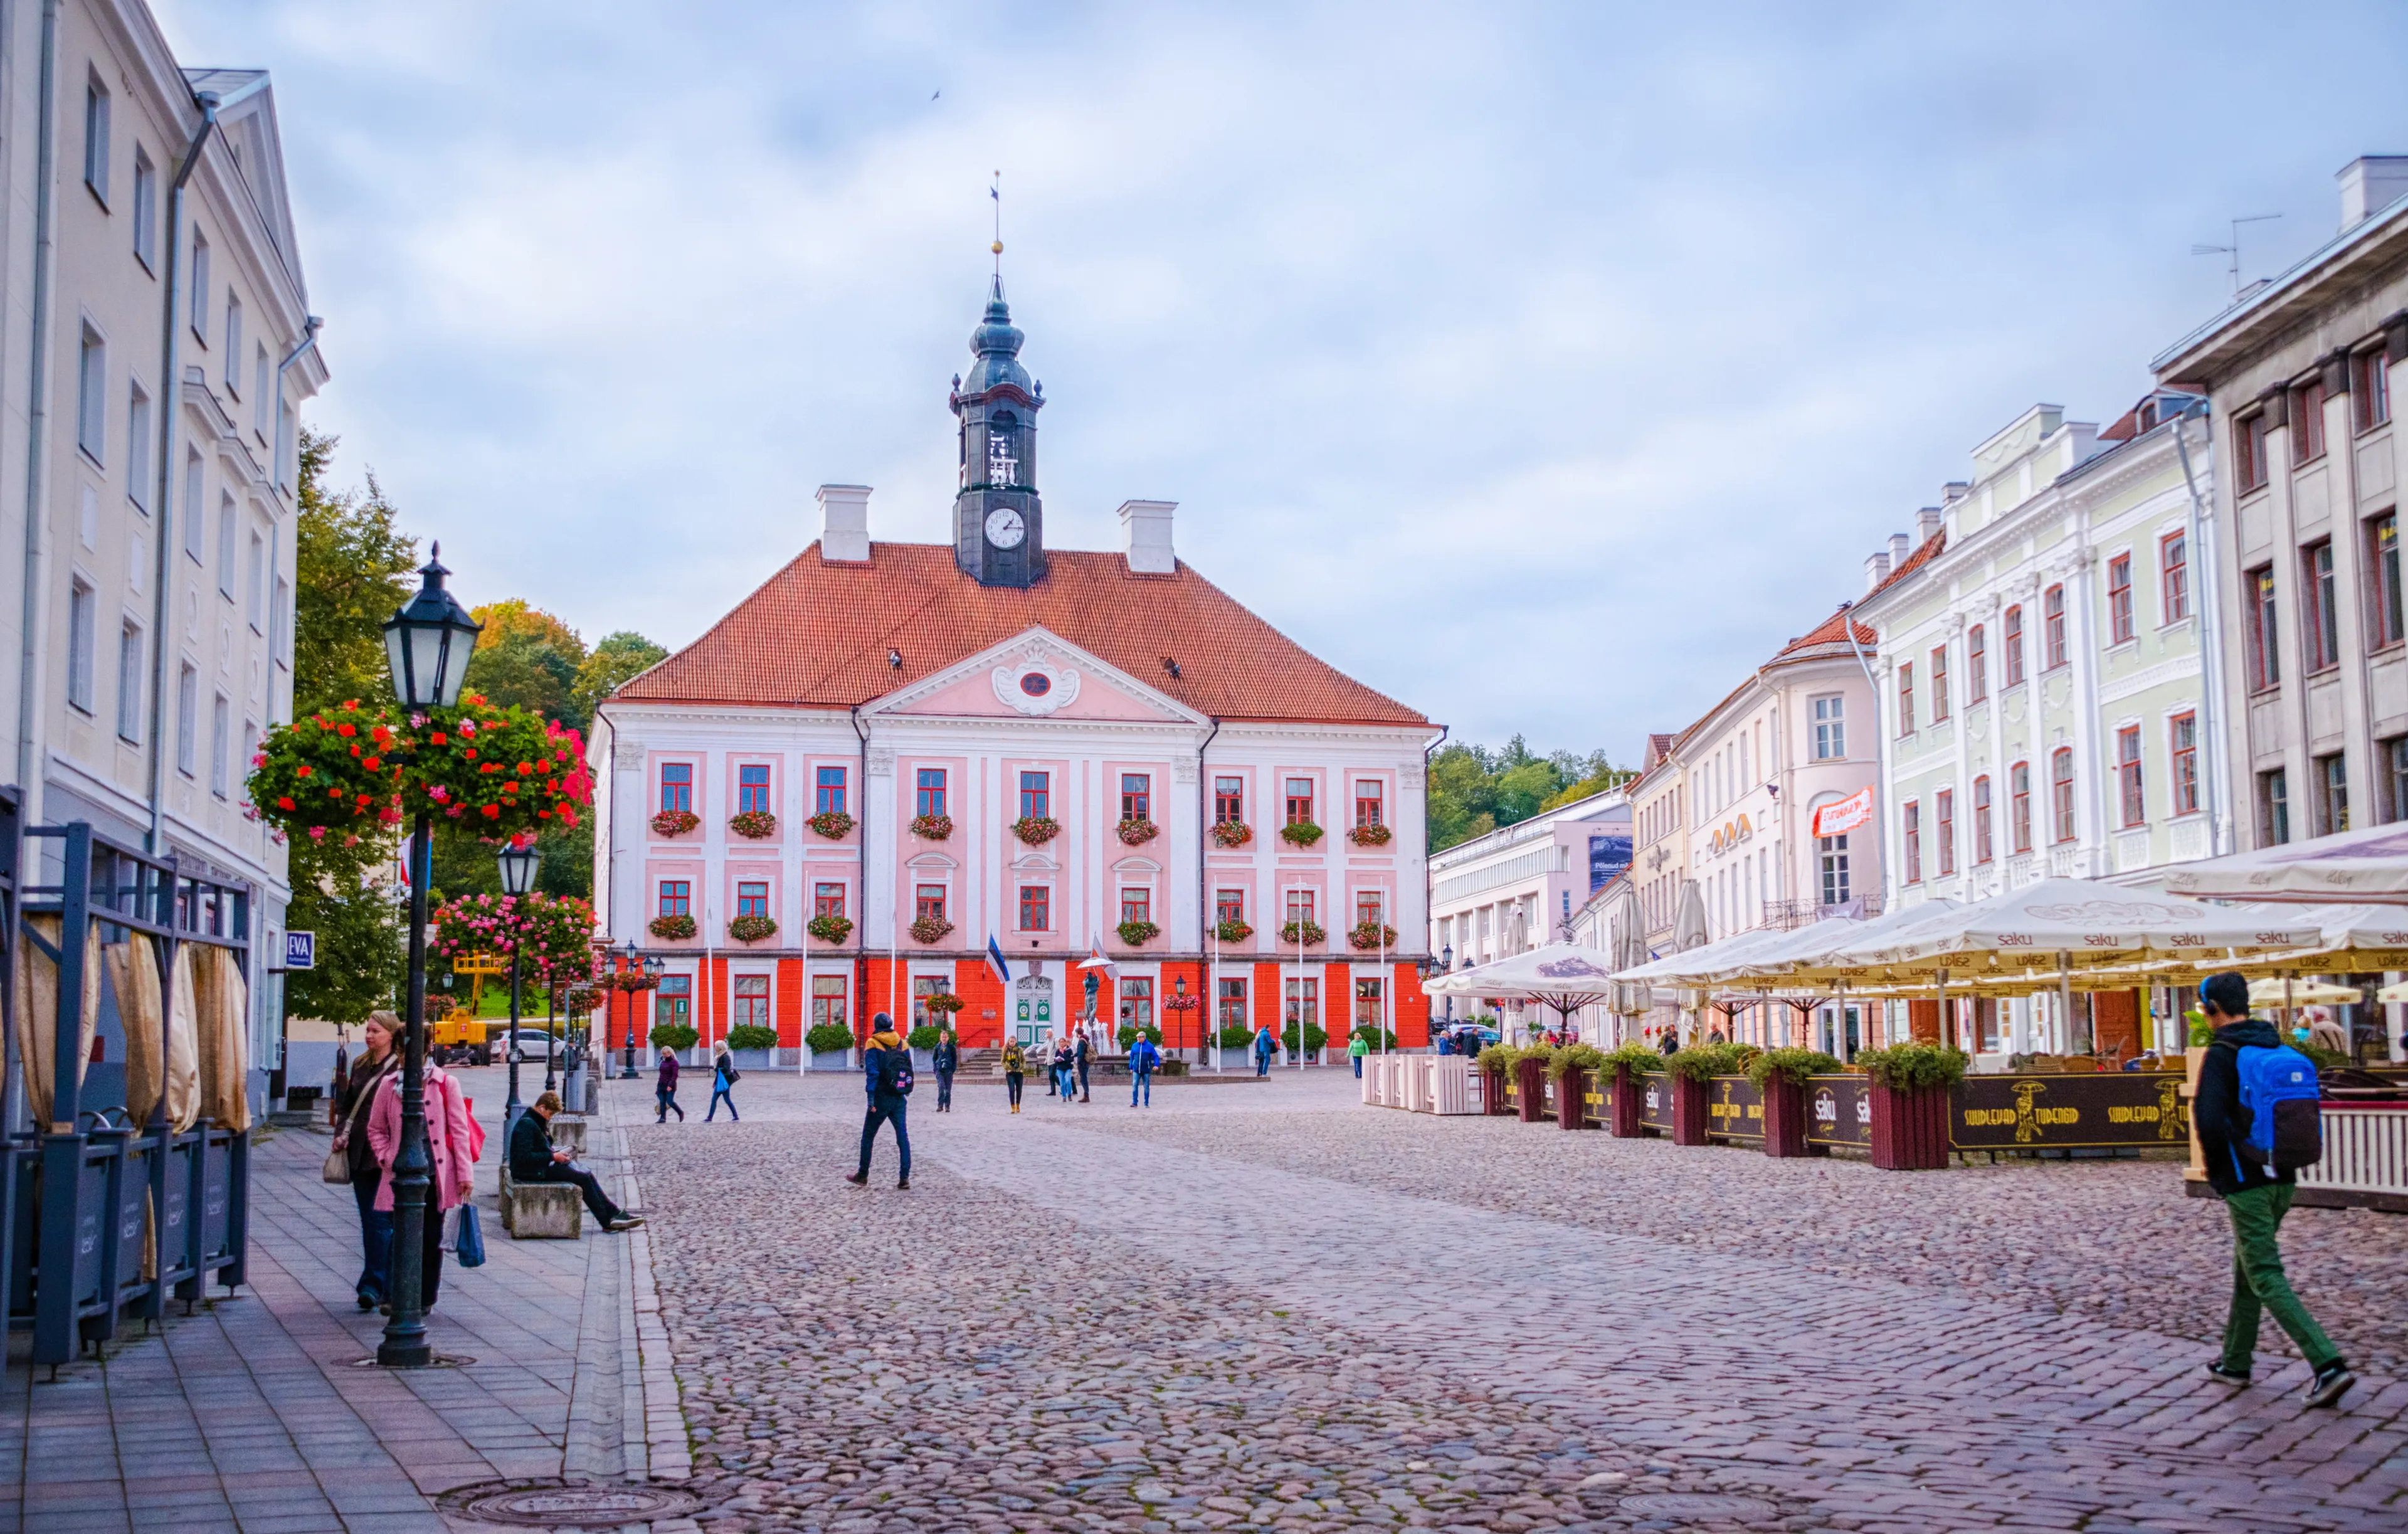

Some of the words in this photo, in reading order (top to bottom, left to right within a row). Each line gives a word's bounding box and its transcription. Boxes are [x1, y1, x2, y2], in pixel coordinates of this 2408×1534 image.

[1998, 933, 2033, 946] saku
[2084, 933, 2118, 946] saku
[2170, 933, 2205, 946] saku
[2255, 931, 2290, 944] saku
[289, 936, 309, 955] EVA
[1815, 1093, 1836, 1120] saku
[1857, 1094, 1871, 1123] sak
